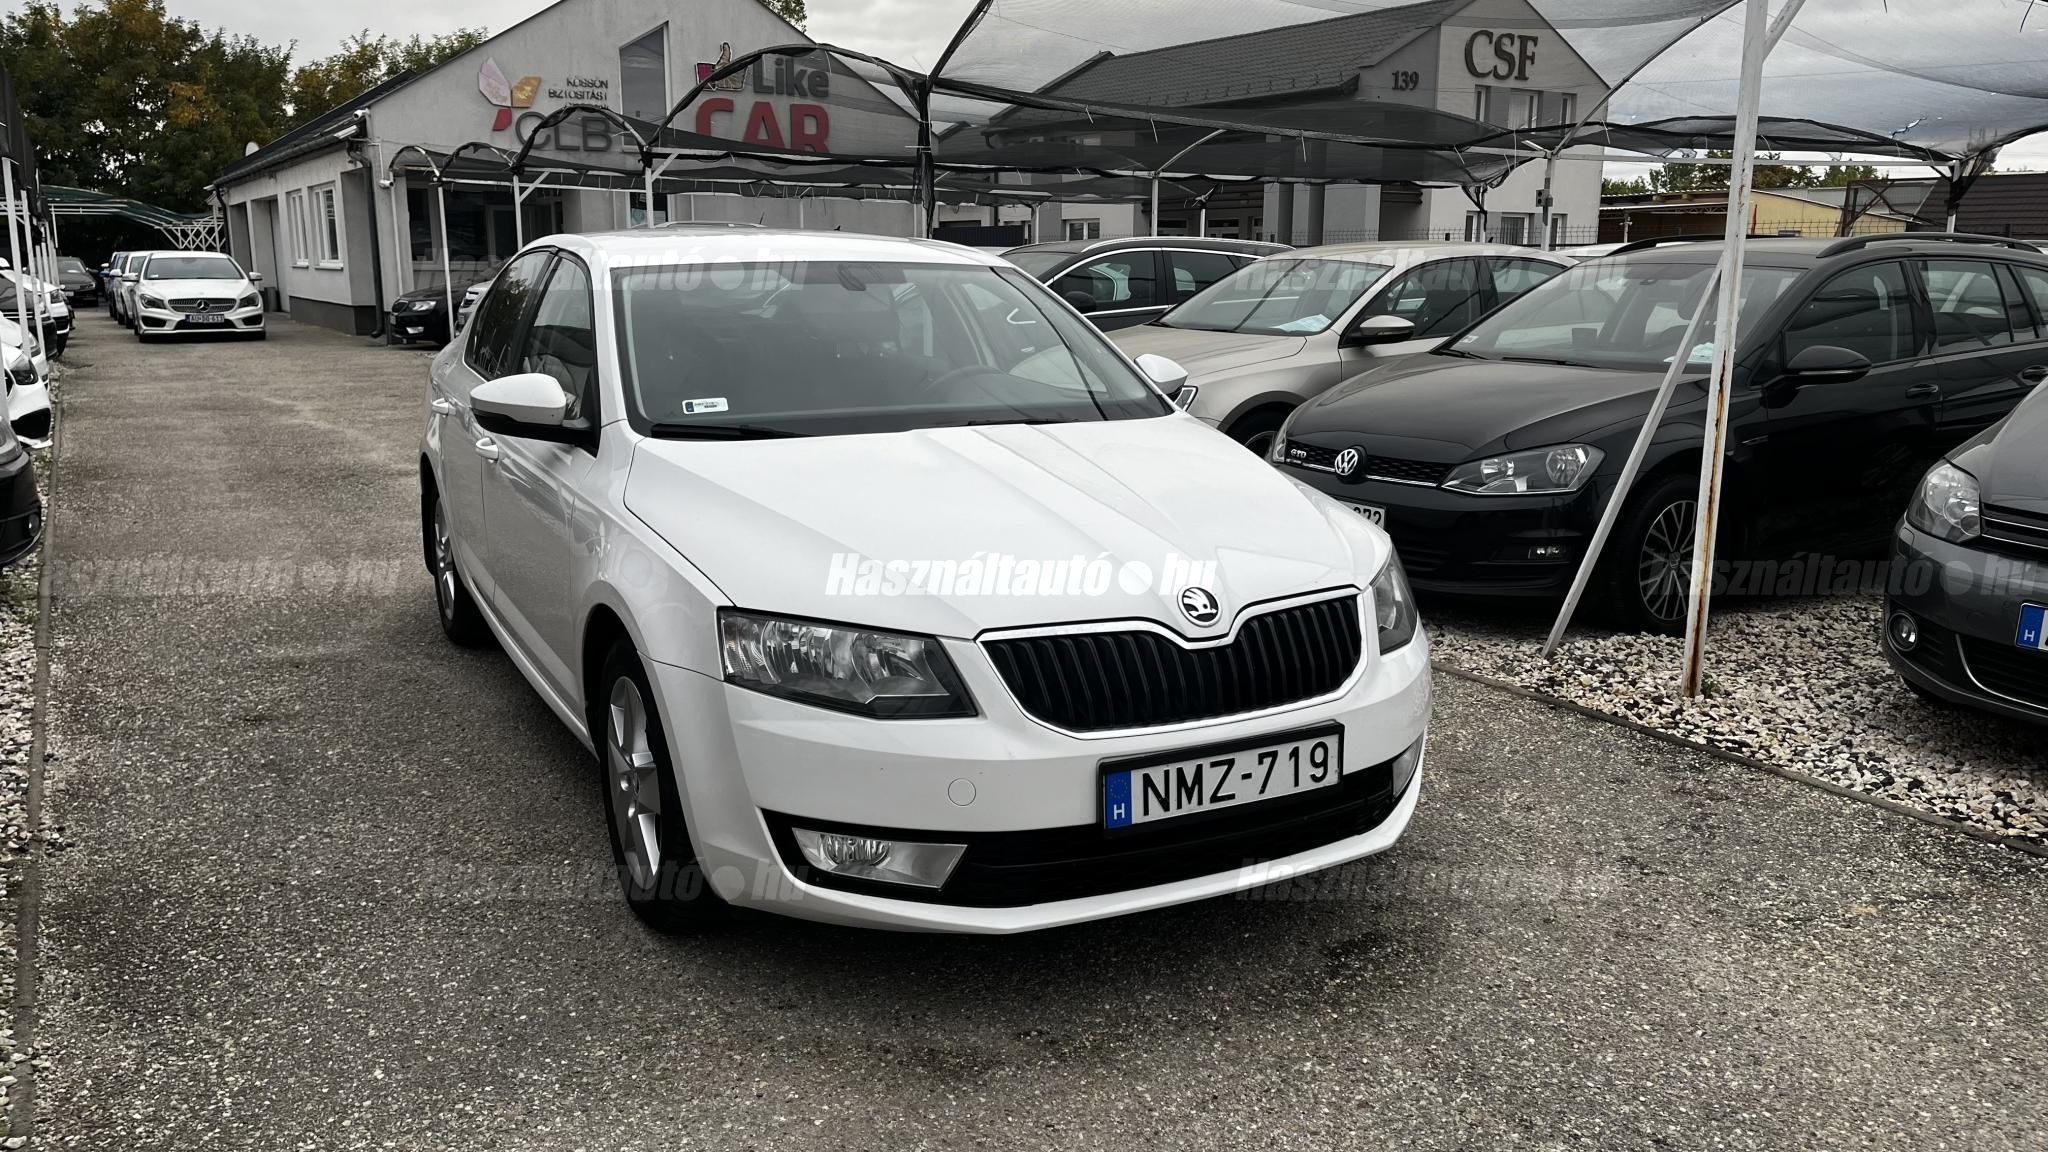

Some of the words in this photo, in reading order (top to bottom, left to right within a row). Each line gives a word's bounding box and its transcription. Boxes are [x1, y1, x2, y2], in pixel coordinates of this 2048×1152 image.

[1465, 30, 1538, 80] CSF
[752, 56, 829, 97] Like
[1392, 70, 1419, 90] 139
[515, 112, 612, 151] CLB
[695, 98, 831, 153] CAR
[2023, 629, 2036, 642] H
[1113, 803, 1125, 820] H
[1142, 741, 1329, 817] NMZ-719
